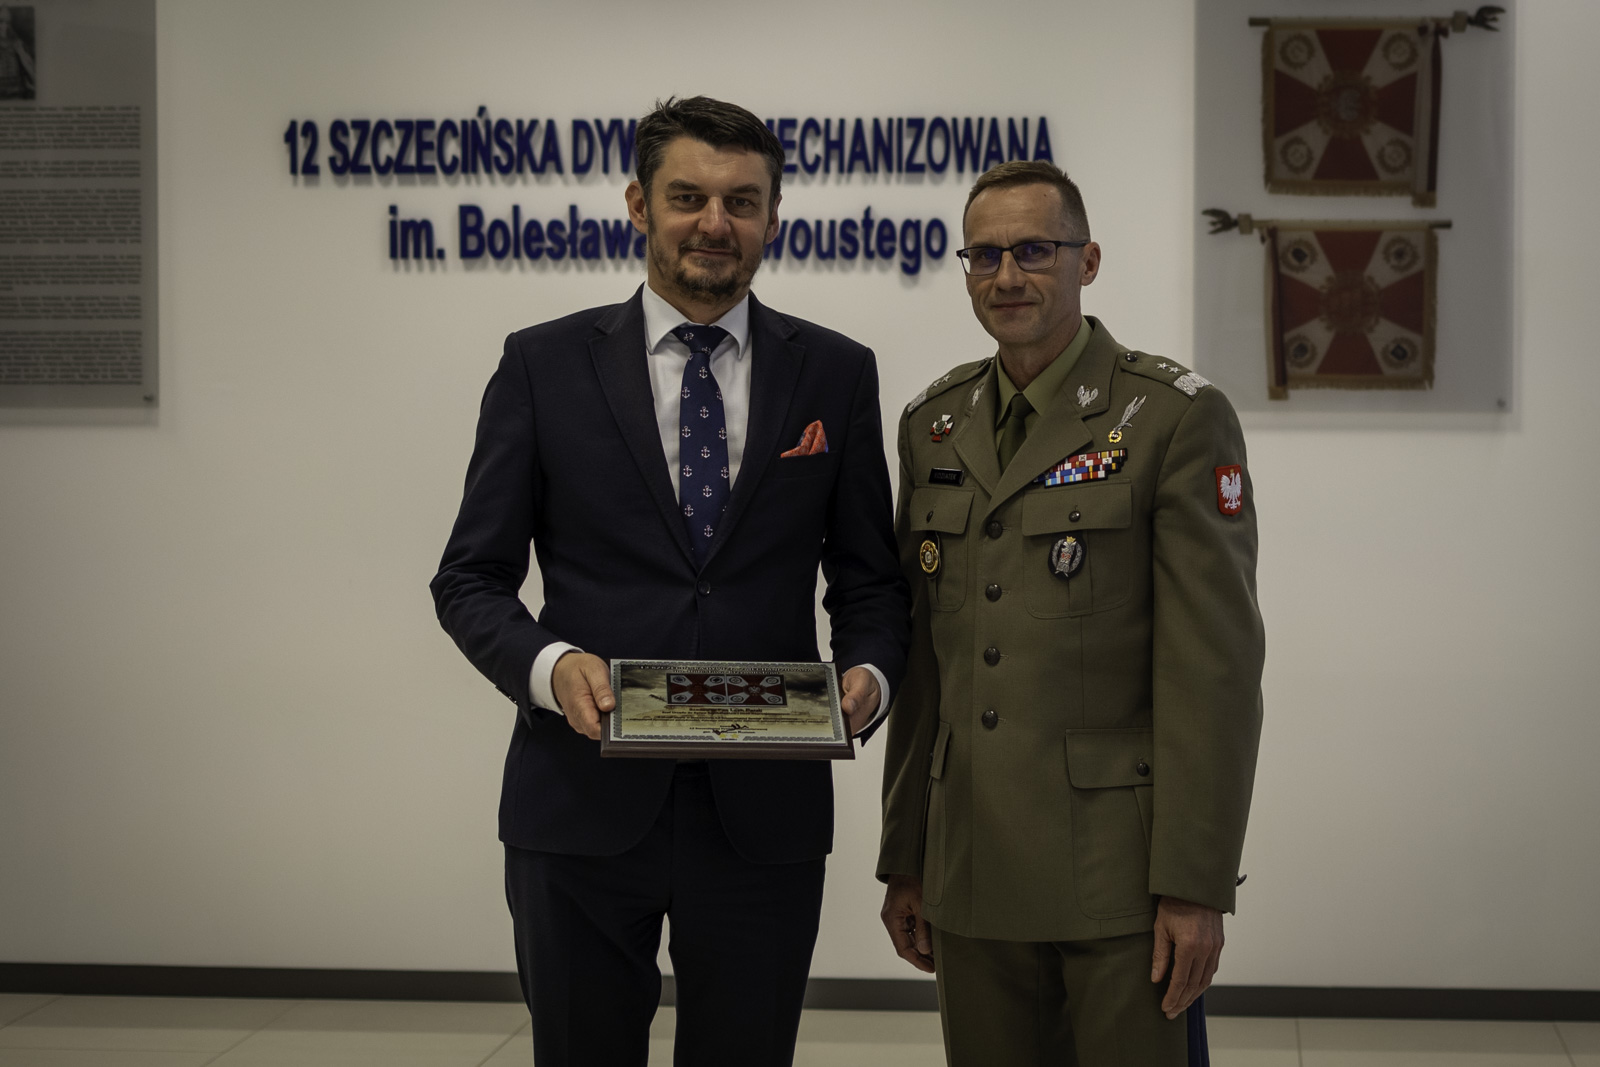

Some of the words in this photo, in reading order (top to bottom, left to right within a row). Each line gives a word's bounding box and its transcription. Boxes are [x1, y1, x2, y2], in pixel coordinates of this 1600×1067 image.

[285, 119, 316, 174] 12
[329, 106, 562, 175] SZCZECIŃSKA
[765, 117, 1053, 175] ECHANIZOWANA
[389, 204, 444, 259] im.
[459, 204, 647, 260] Bolesława
[761, 208, 948, 275] woustego
